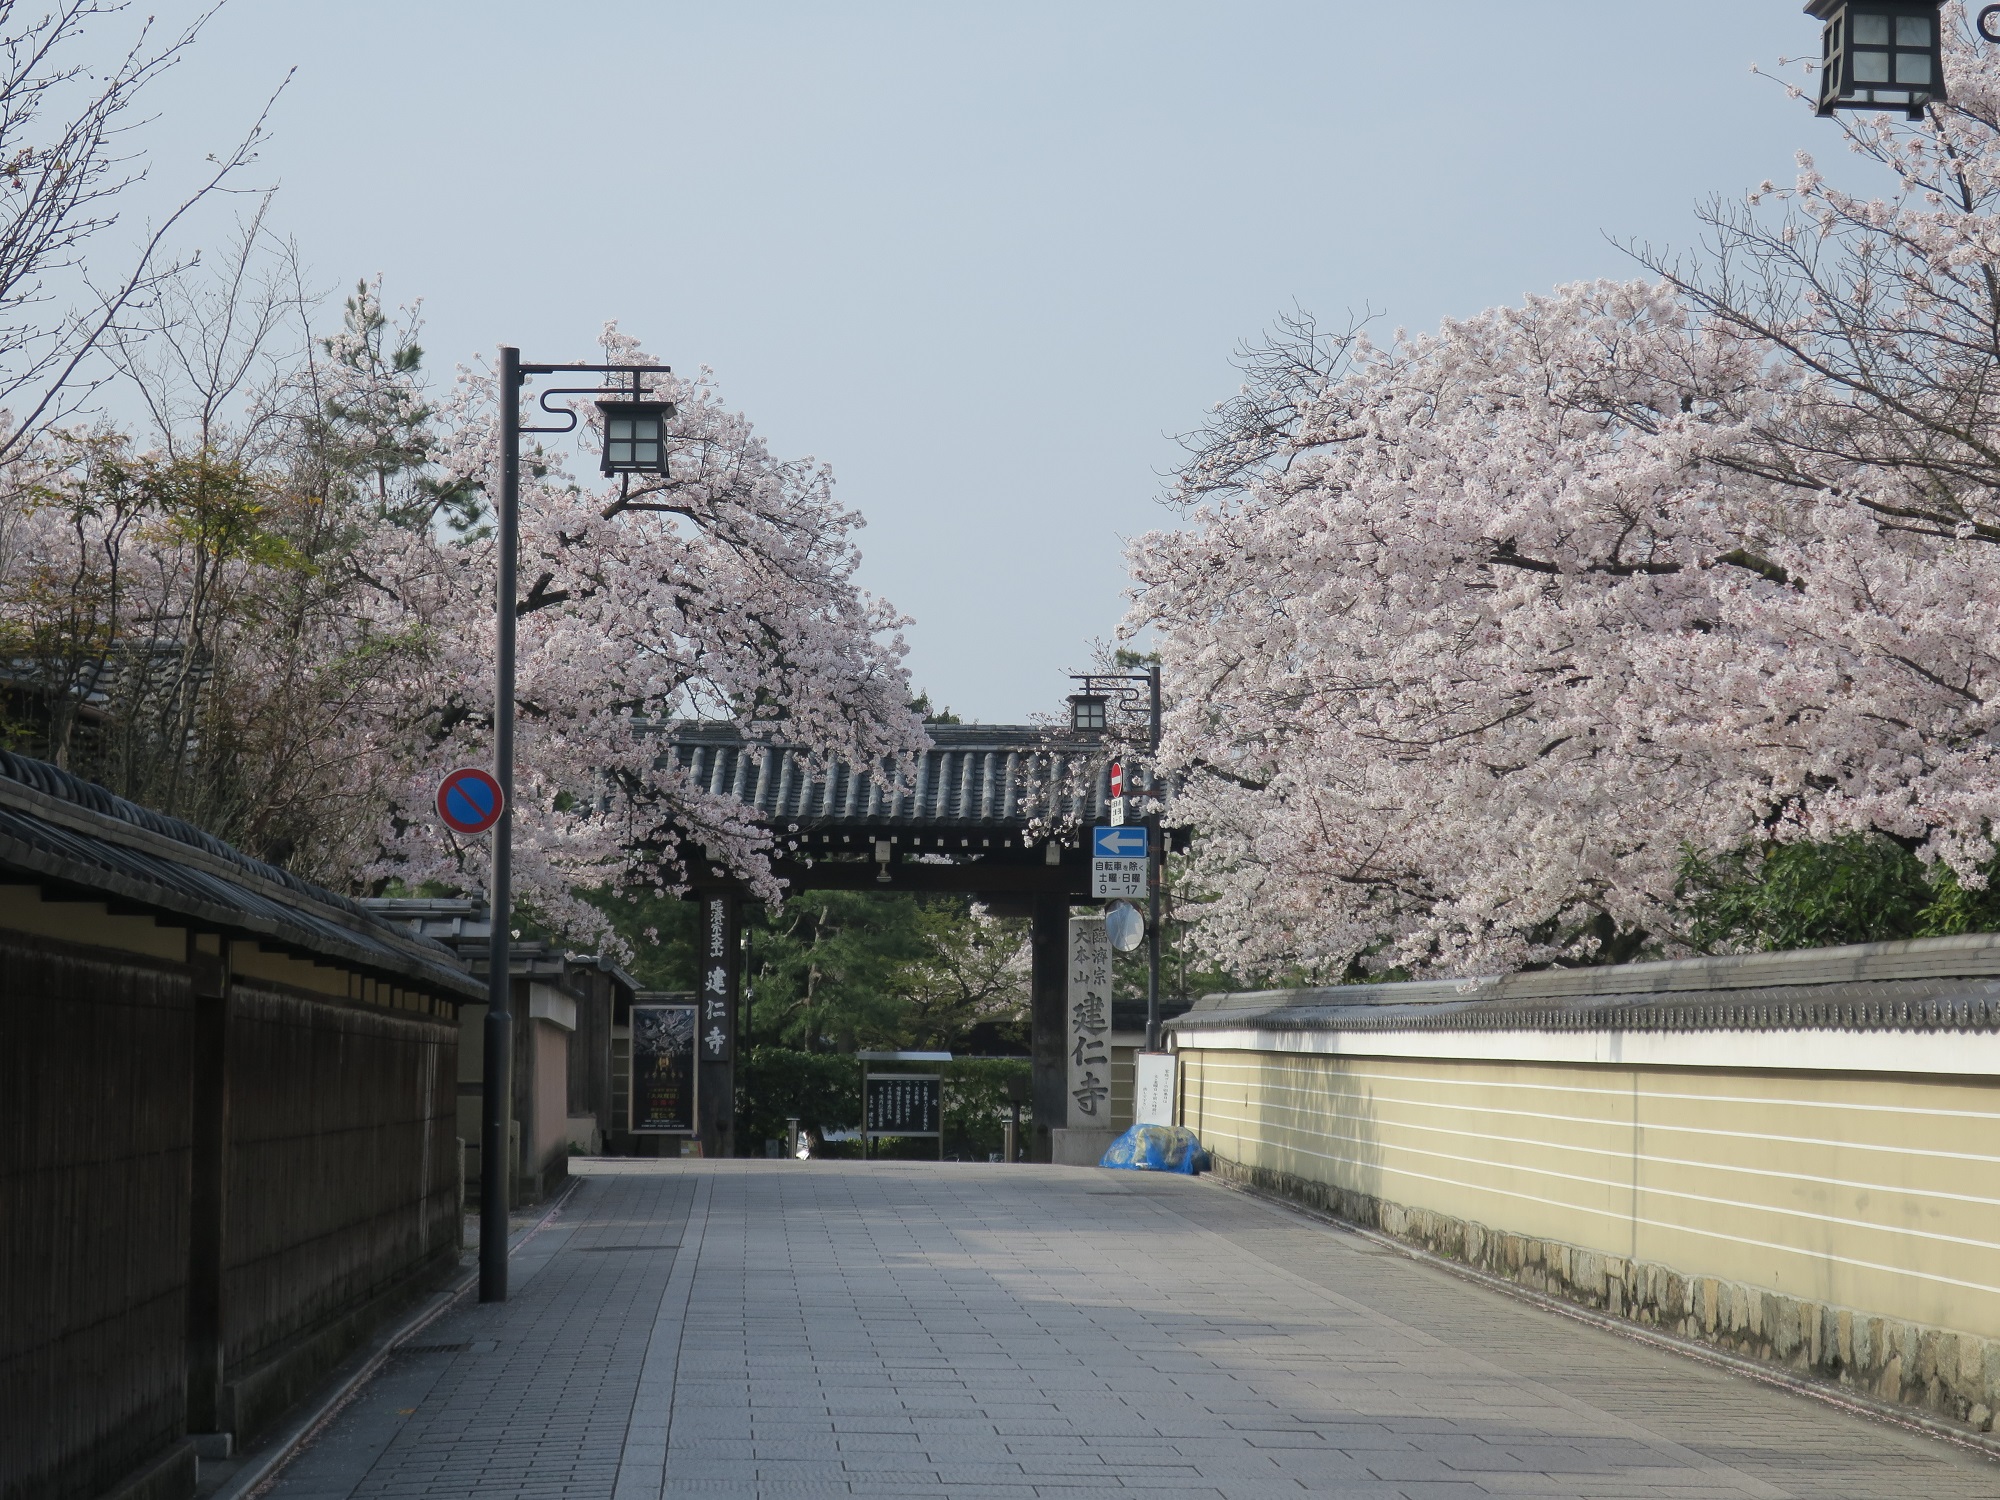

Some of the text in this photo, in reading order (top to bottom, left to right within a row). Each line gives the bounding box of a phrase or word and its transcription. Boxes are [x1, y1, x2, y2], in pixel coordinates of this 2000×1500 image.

[1096, 861, 1143, 871] 自転車を除く
[1099, 873, 1140, 883] 土曜・日曜
[1073, 927, 1091, 984] 大本山
[705, 966, 726, 1055] 建仁寺
[1071, 992, 1108, 1116] 建仁寺
